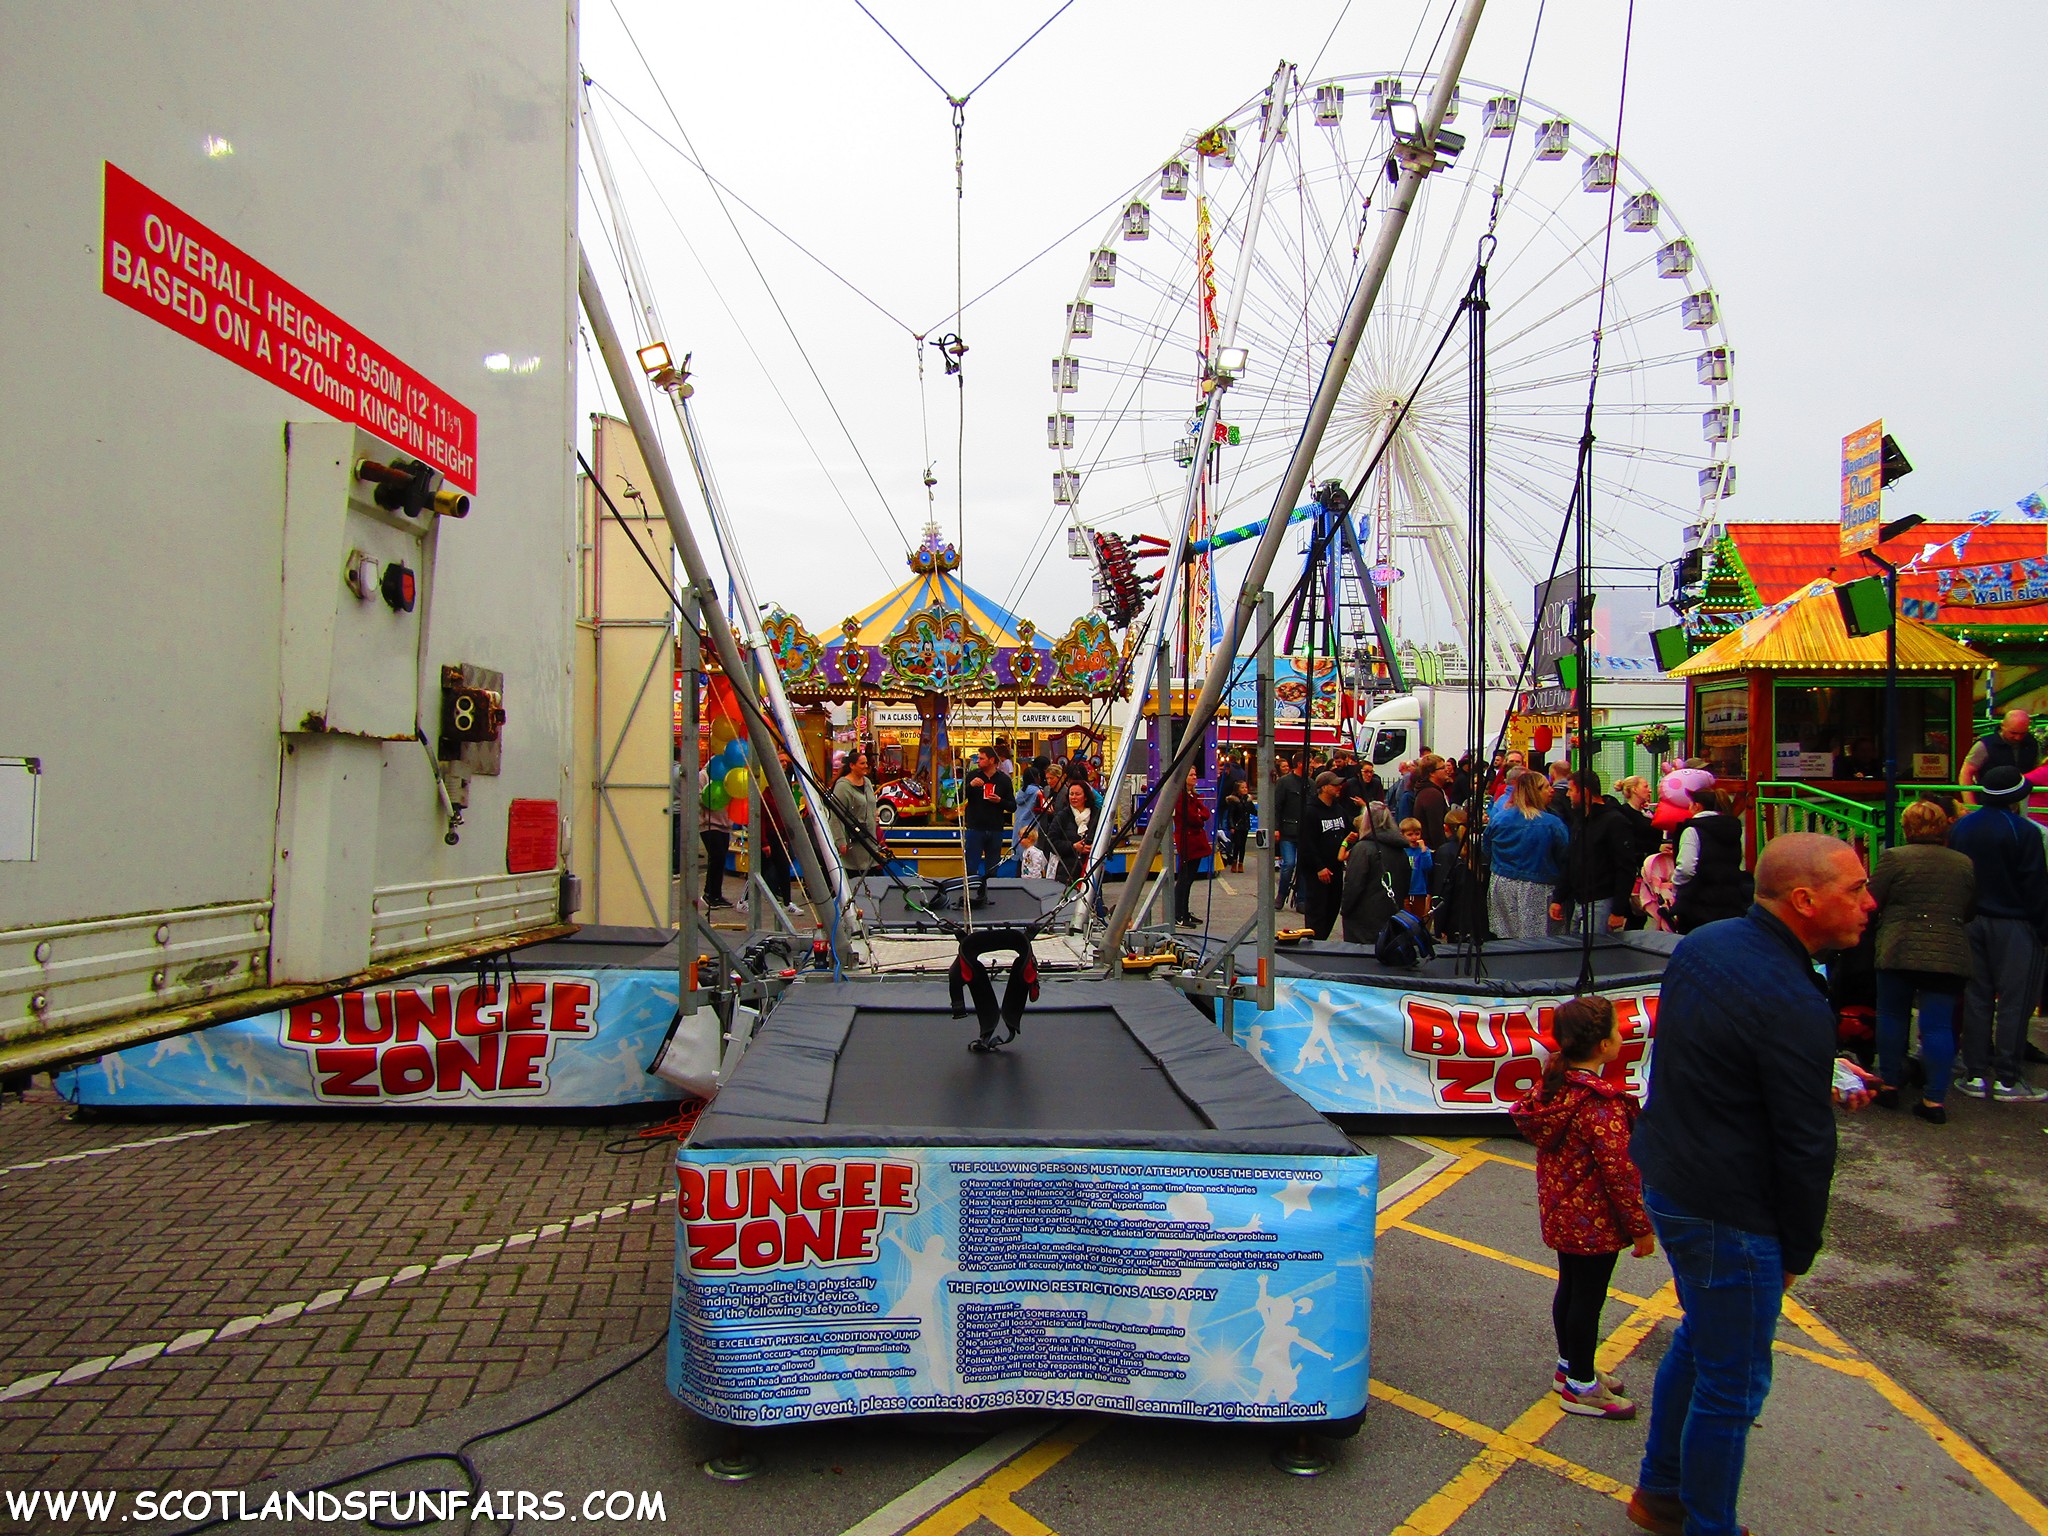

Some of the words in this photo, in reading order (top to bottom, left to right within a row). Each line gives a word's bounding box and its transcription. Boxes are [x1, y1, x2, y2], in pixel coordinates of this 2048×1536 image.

[144, 214, 261, 315] OVERALL
[267, 291, 341, 363] HEIGHT
[346, 343, 402, 403] 3.950M
[111, 241, 207, 326] BASED
[214, 303, 250, 351] ON
[256, 329, 272, 365] A
[278, 342, 355, 412] 1270mm
[360, 398, 423, 452] KINGPIN
[426, 430, 474, 480] HEIGHT
[1849, 475, 1872, 503] Fun
[1843, 501, 1879, 531] House
[1971, 586, 2014, 604] Walk
[879, 713, 886, 721] IN
[893, 713, 912, 721] CLASS
[1022, 714, 1050, 722] CARVERY
[1058, 715, 1076, 723] GRILL
[288, 982, 591, 1046] BUNGEE
[316, 1034, 549, 1097] ZONE
[1437, 1041, 1645, 1103] ZOE
[951, 1163, 971, 1172] THE
[973, 1163, 1037, 1173] FOLLOWING
[1040, 1163, 1088, 1174] PERSONS
[1090, 1165, 1118, 1174] MUST
[1121, 1166, 1142, 1175] NOT
[1145, 1167, 1191, 1177] ATTEMPT
[1194, 1168, 1207, 1177] TO
[1210, 1169, 1230, 1178] USE
[1232, 1169, 1252, 1179] THE
[1254, 1170, 1292, 1180] DEVICE
[1294, 1171, 1322, 1180] WHO
[676, 1164, 912, 1222] BUNGEE
[968, 1189, 984, 1197] Are
[986, 1189, 1009, 1197] under
[1027, 1189, 1064, 1197] influence
[1077, 1190, 1100, 1200] drugs
[1113, 1192, 1143, 1200] alcohol
[969, 1180, 989, 1188] Have
[991, 1180, 1011, 1188] neck
[1013, 1180, 1043, 1189] injuries
[1056, 1180, 1073, 1188] who
[1075, 1181, 1094, 1189] have
[1096, 1182, 1129, 1190] suffered
[1186, 1184, 1204, 1192] from
[1207, 1185, 1226, 1193] neck
[1227, 1185, 1256, 1195] injuries
[991, 1198, 1012, 1206] heart
[1014, 1198, 1053, 1208] problems
[1065, 1199, 1088, 1208] suffer
[1090, 1201, 1110, 1209] from
[1112, 1201, 1166, 1211] hypertension
[991, 1207, 1036, 1217] Pre-injured
[1038, 1207, 1071, 1215] tendons
[968, 1217, 989, 1225] Have
[991, 1216, 1006, 1225] had
[1008, 1216, 1044, 1224] fractures
[1046, 1217, 1092, 1227] particularly
[1104, 1219, 1119, 1227] the
[1121, 1220, 1156, 1228] shoulder
[687, 1209, 877, 1271] ZONE
[985, 1234, 1022, 1244] Pregnant
[690, 1281, 726, 1296] Bungee
[729, 1280, 795, 1295] Trampoline
[797, 1280, 806, 1290] is
[809, 1282, 816, 1290] a
[819, 1278, 876, 1291] physically
[948, 1282, 972, 1293] THE
[975, 1281, 1049, 1294] FOLLOWING
[1051, 1281, 1139, 1298] RESTRICTIONS
[1141, 1286, 1175, 1299] ALSO
[1178, 1288, 1216, 1300] APPLY
[742, 1293, 768, 1305] high
[772, 1291, 814, 1304] activity
[817, 1291, 858, 1302] device.
[699, 1308, 723, 1320] read
[726, 1308, 745, 1319] the
[748, 1305, 802, 1317] following
[805, 1303, 840, 1316] safety
[842, 1303, 879, 1313] notice
[966, 1304, 993, 1312] Riders
[994, 1303, 1013, 1311] must
[966, 1313, 986, 1321] NOT
[987, 1310, 1024, 1320] ATTEMPT
[1025, 1310, 1087, 1319] SOMERSAULTS
[706, 1338, 717, 1348] BE
[719, 1336, 773, 1348] EXCELLENT
[775, 1334, 821, 1345] PHYSICAL
[823, 1331, 876, 1343] CONDITION
[879, 1331, 892, 1340] TO
[893, 1331, 920, 1340] JUMP
[965, 1330, 989, 1338] Shirts
[991, 1329, 1010, 1337] must
[678, 1385, 715, 1414] Available
[715, 1405, 728, 1417] to
[731, 1406, 757, 1419] hire
[761, 1405, 781, 1419] for
[784, 1404, 811, 1418] any
[814, 1400, 857, 1414] event,
[860, 1396, 906, 1413] please
[909, 1394, 964, 1408] contact
[967, 1391, 1014, 1408] :07896
[1016, 1390, 1044, 1405] 307
[1047, 1391, 1074, 1405] 545
[1077, 1395, 1093, 1406] or
[1095, 1396, 1135, 1410] email
[1136, 1401, 1326, 1419] seanmiller21@hotmail.co.uk
